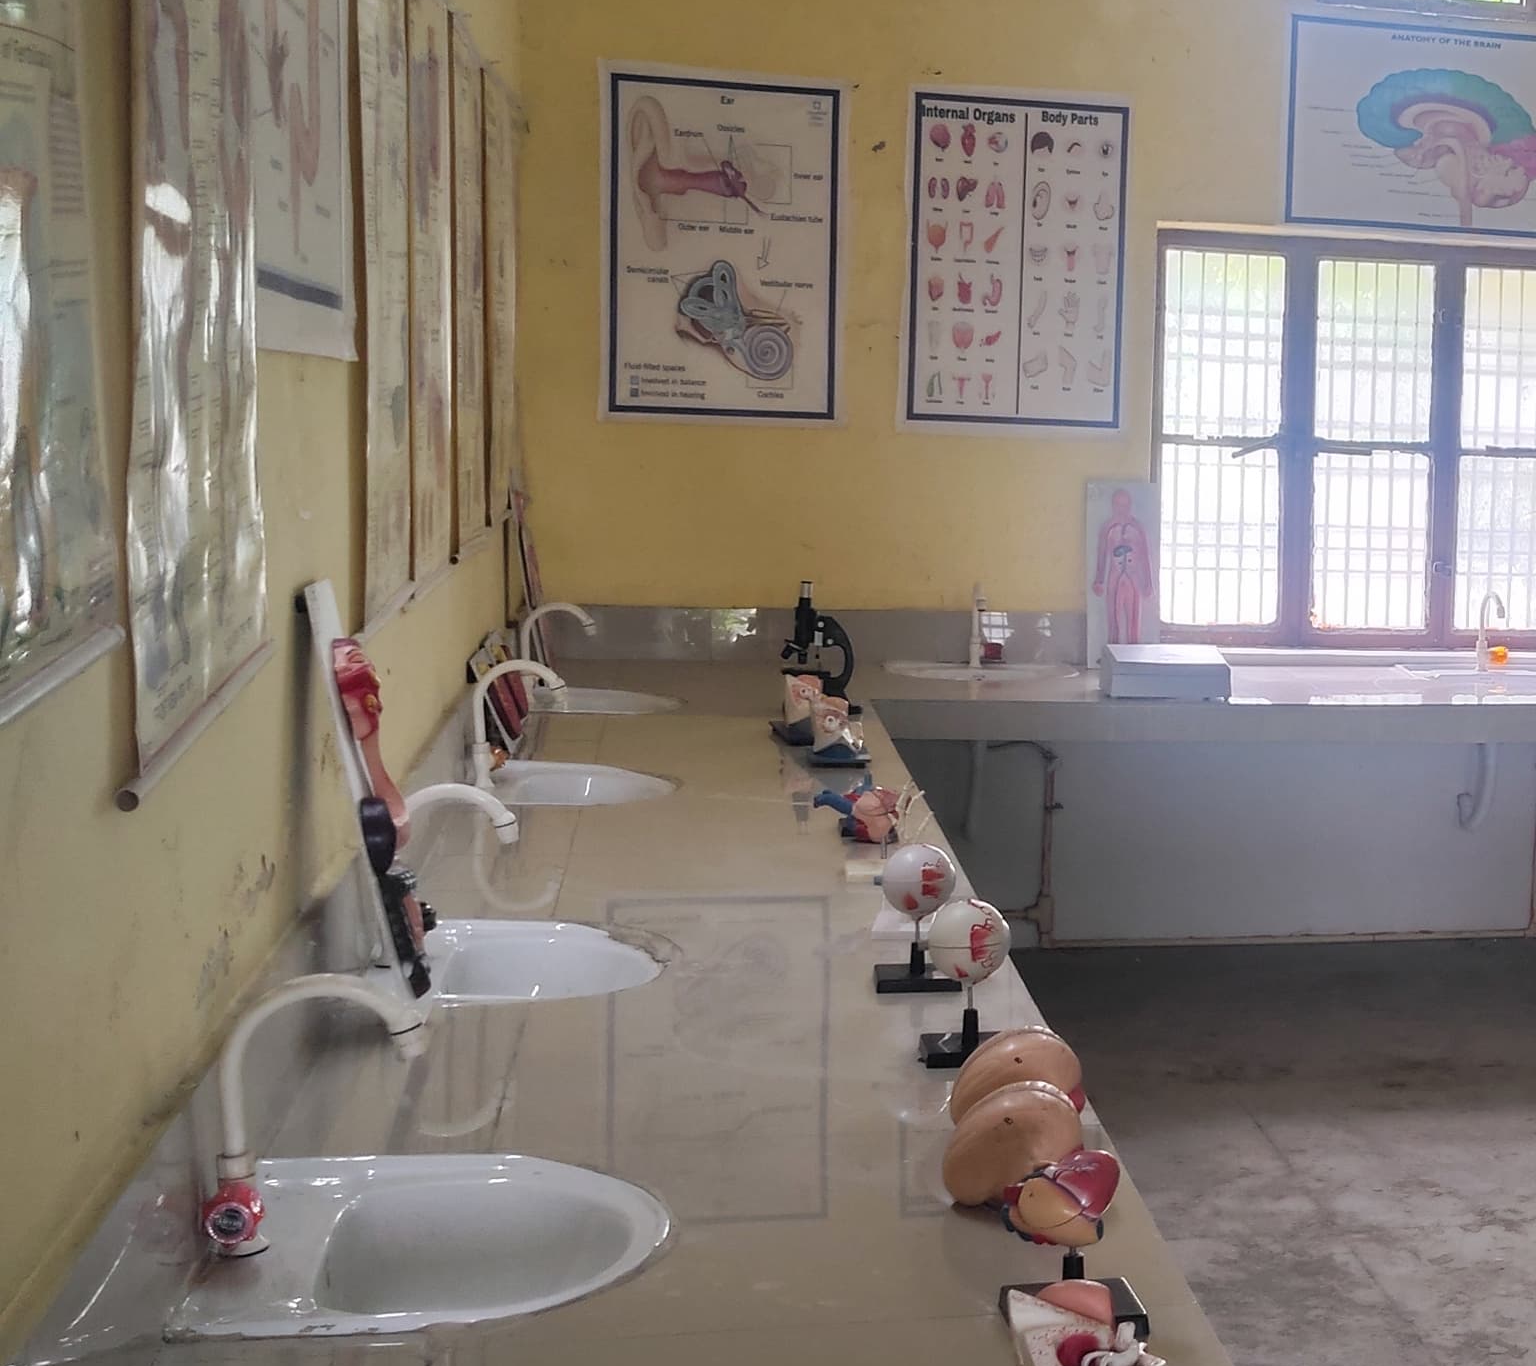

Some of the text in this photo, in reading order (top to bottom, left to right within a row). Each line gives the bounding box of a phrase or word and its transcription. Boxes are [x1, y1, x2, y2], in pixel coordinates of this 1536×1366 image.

[1391, 33, 1501, 51] ANATOMY OF THE BRAIN
[720, 96, 735, 105] Ear
[921, 104, 1016, 124] Internal Organs
[1041, 110, 1099, 126] Body Parts
